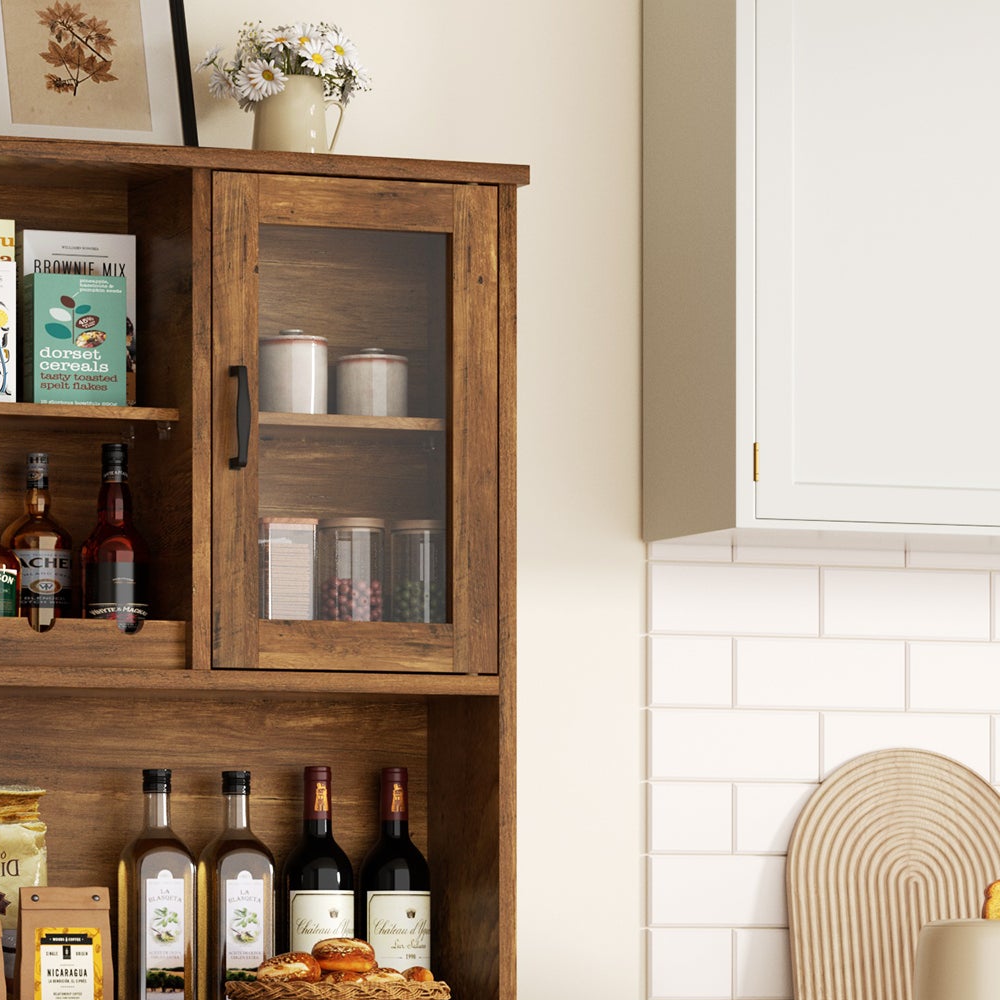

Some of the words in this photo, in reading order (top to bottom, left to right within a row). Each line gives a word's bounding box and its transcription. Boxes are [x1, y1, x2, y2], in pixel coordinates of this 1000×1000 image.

[34, 259, 95, 275] BROWNIE
[102, 262, 126, 277] MIX
[40, 347, 101, 360] dorset
[40, 361, 109, 372] cereals
[40, 372, 71, 381] tasty
[73, 373, 118, 382] toasted
[40, 382, 70, 390] spelt
[73, 382, 108, 391] flakes
[47, 968, 88, 977] NICARAGUA
